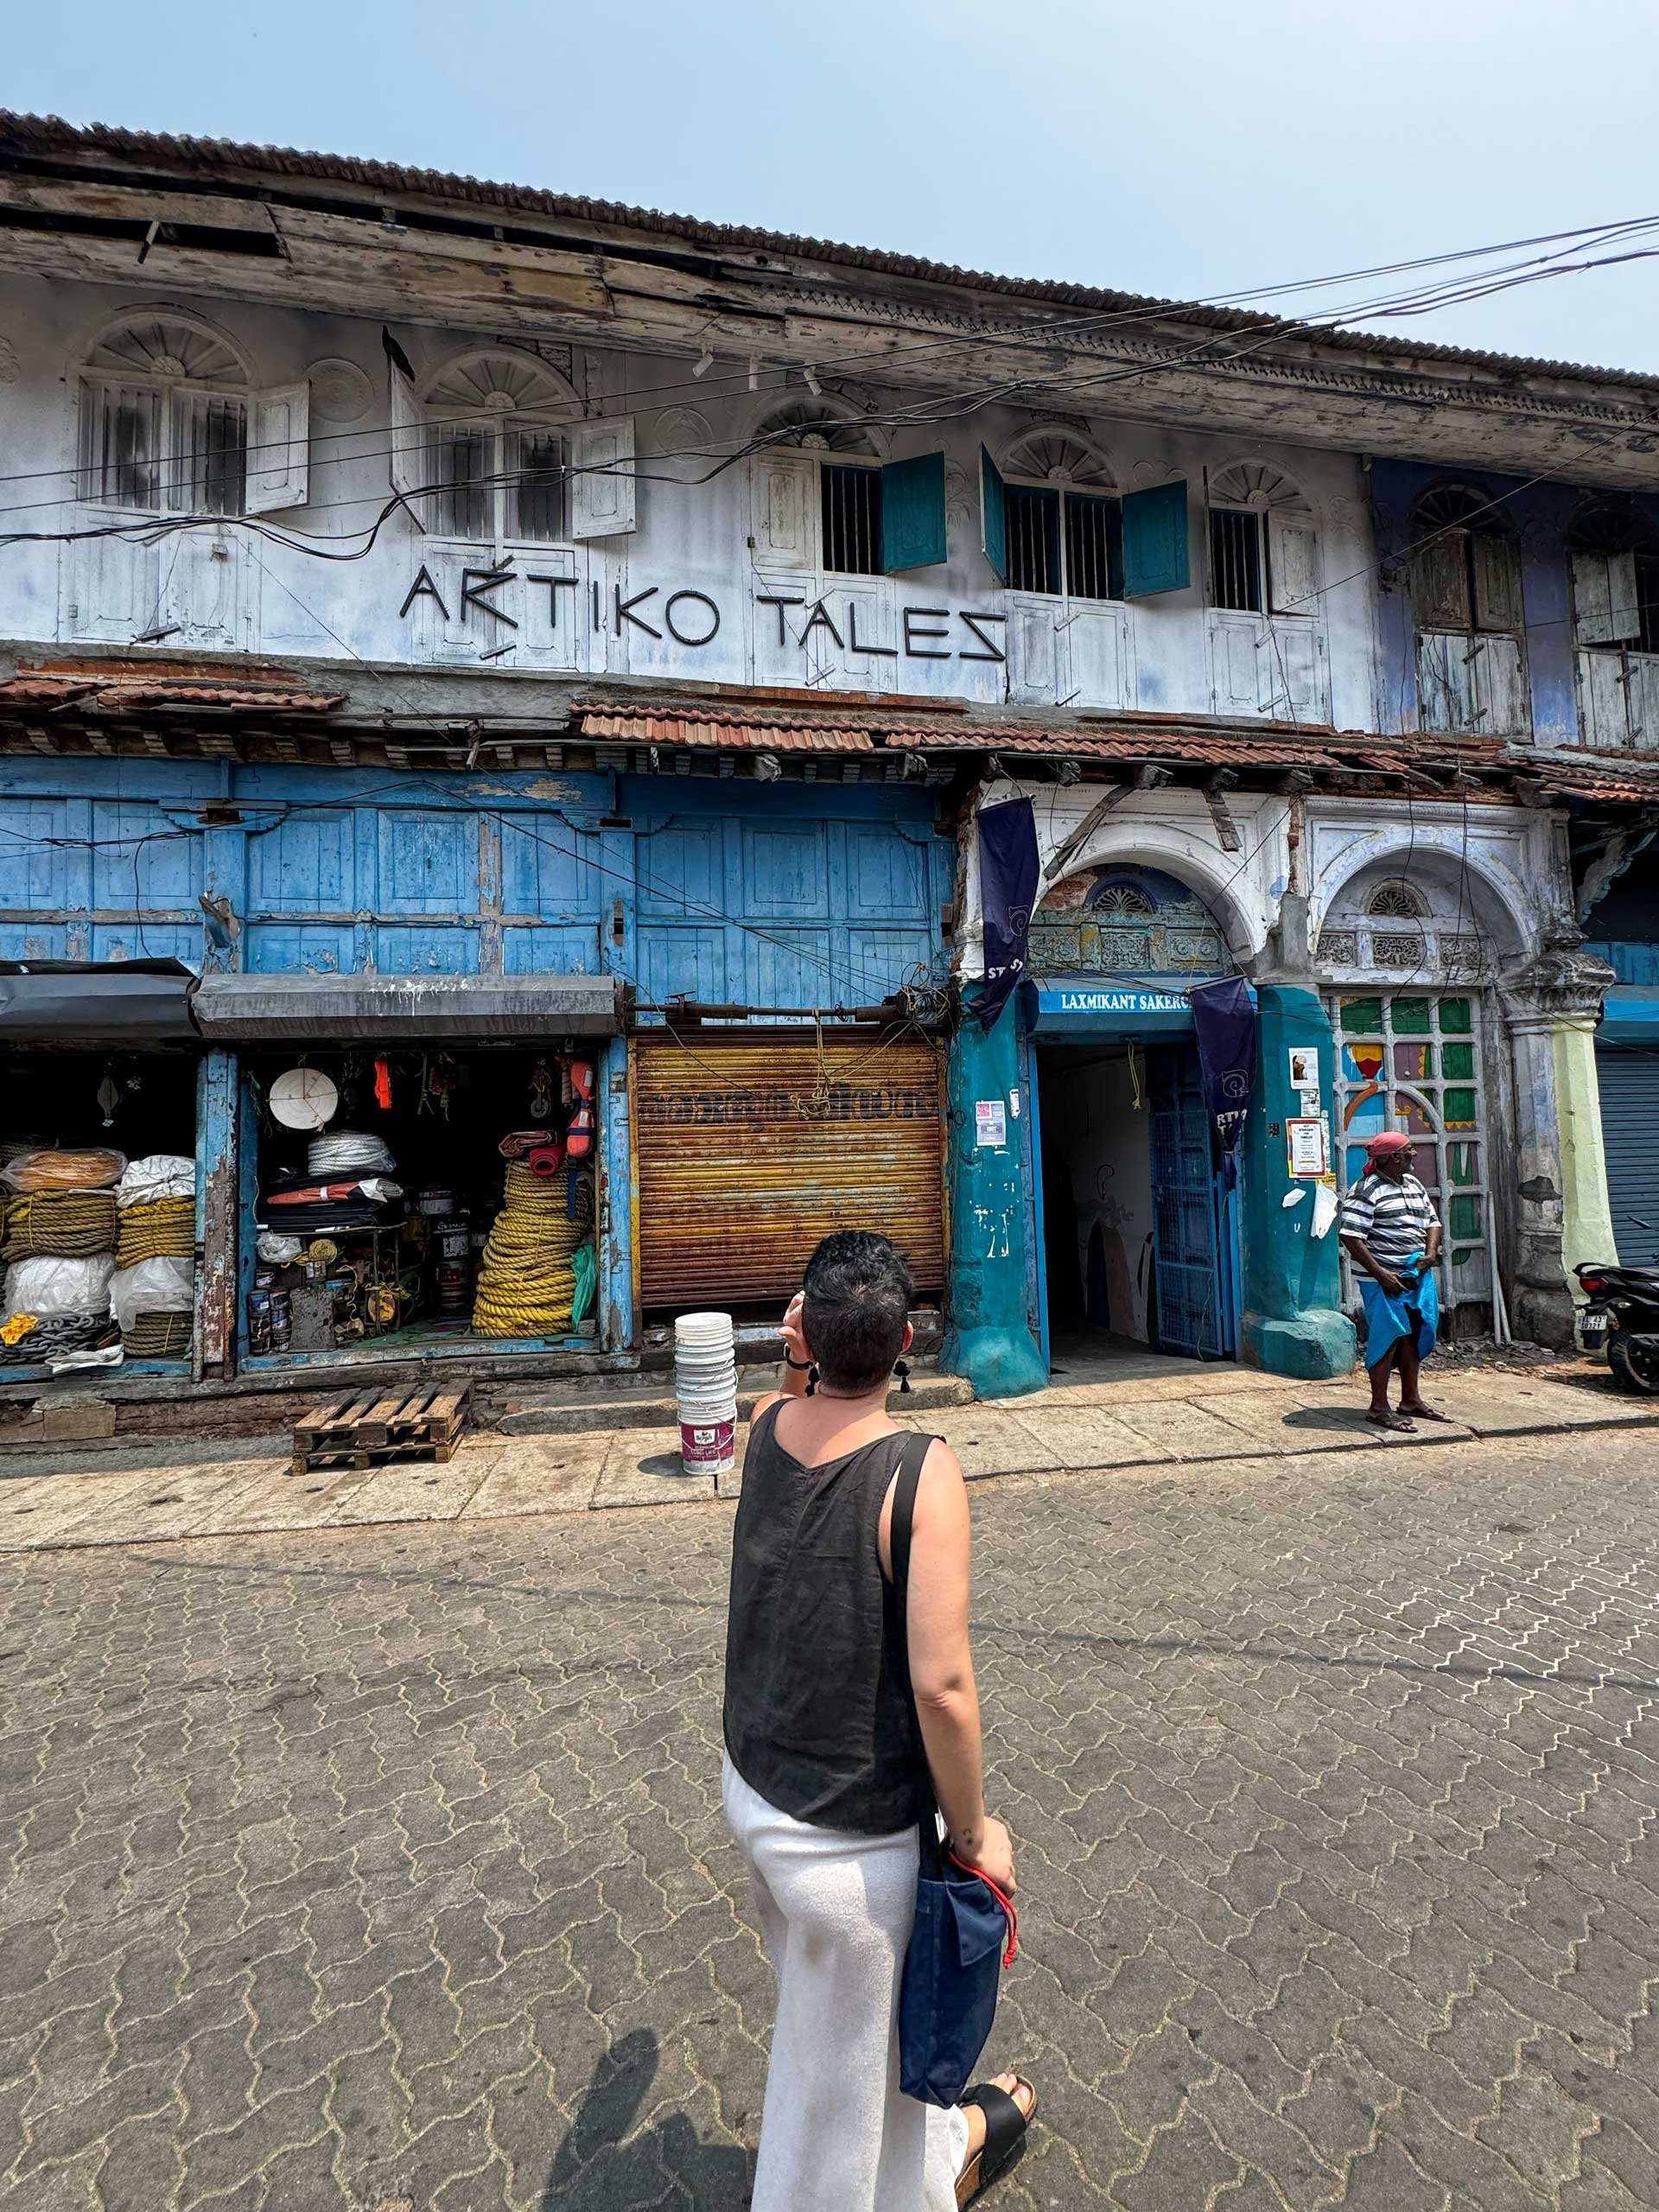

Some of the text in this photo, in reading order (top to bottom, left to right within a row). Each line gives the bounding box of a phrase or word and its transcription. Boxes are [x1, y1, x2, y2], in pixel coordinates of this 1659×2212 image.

[399, 565, 1007, 661] ARTIKO TALES
[1062, 994, 1193, 1010] LAXMIKANT SAKERC
